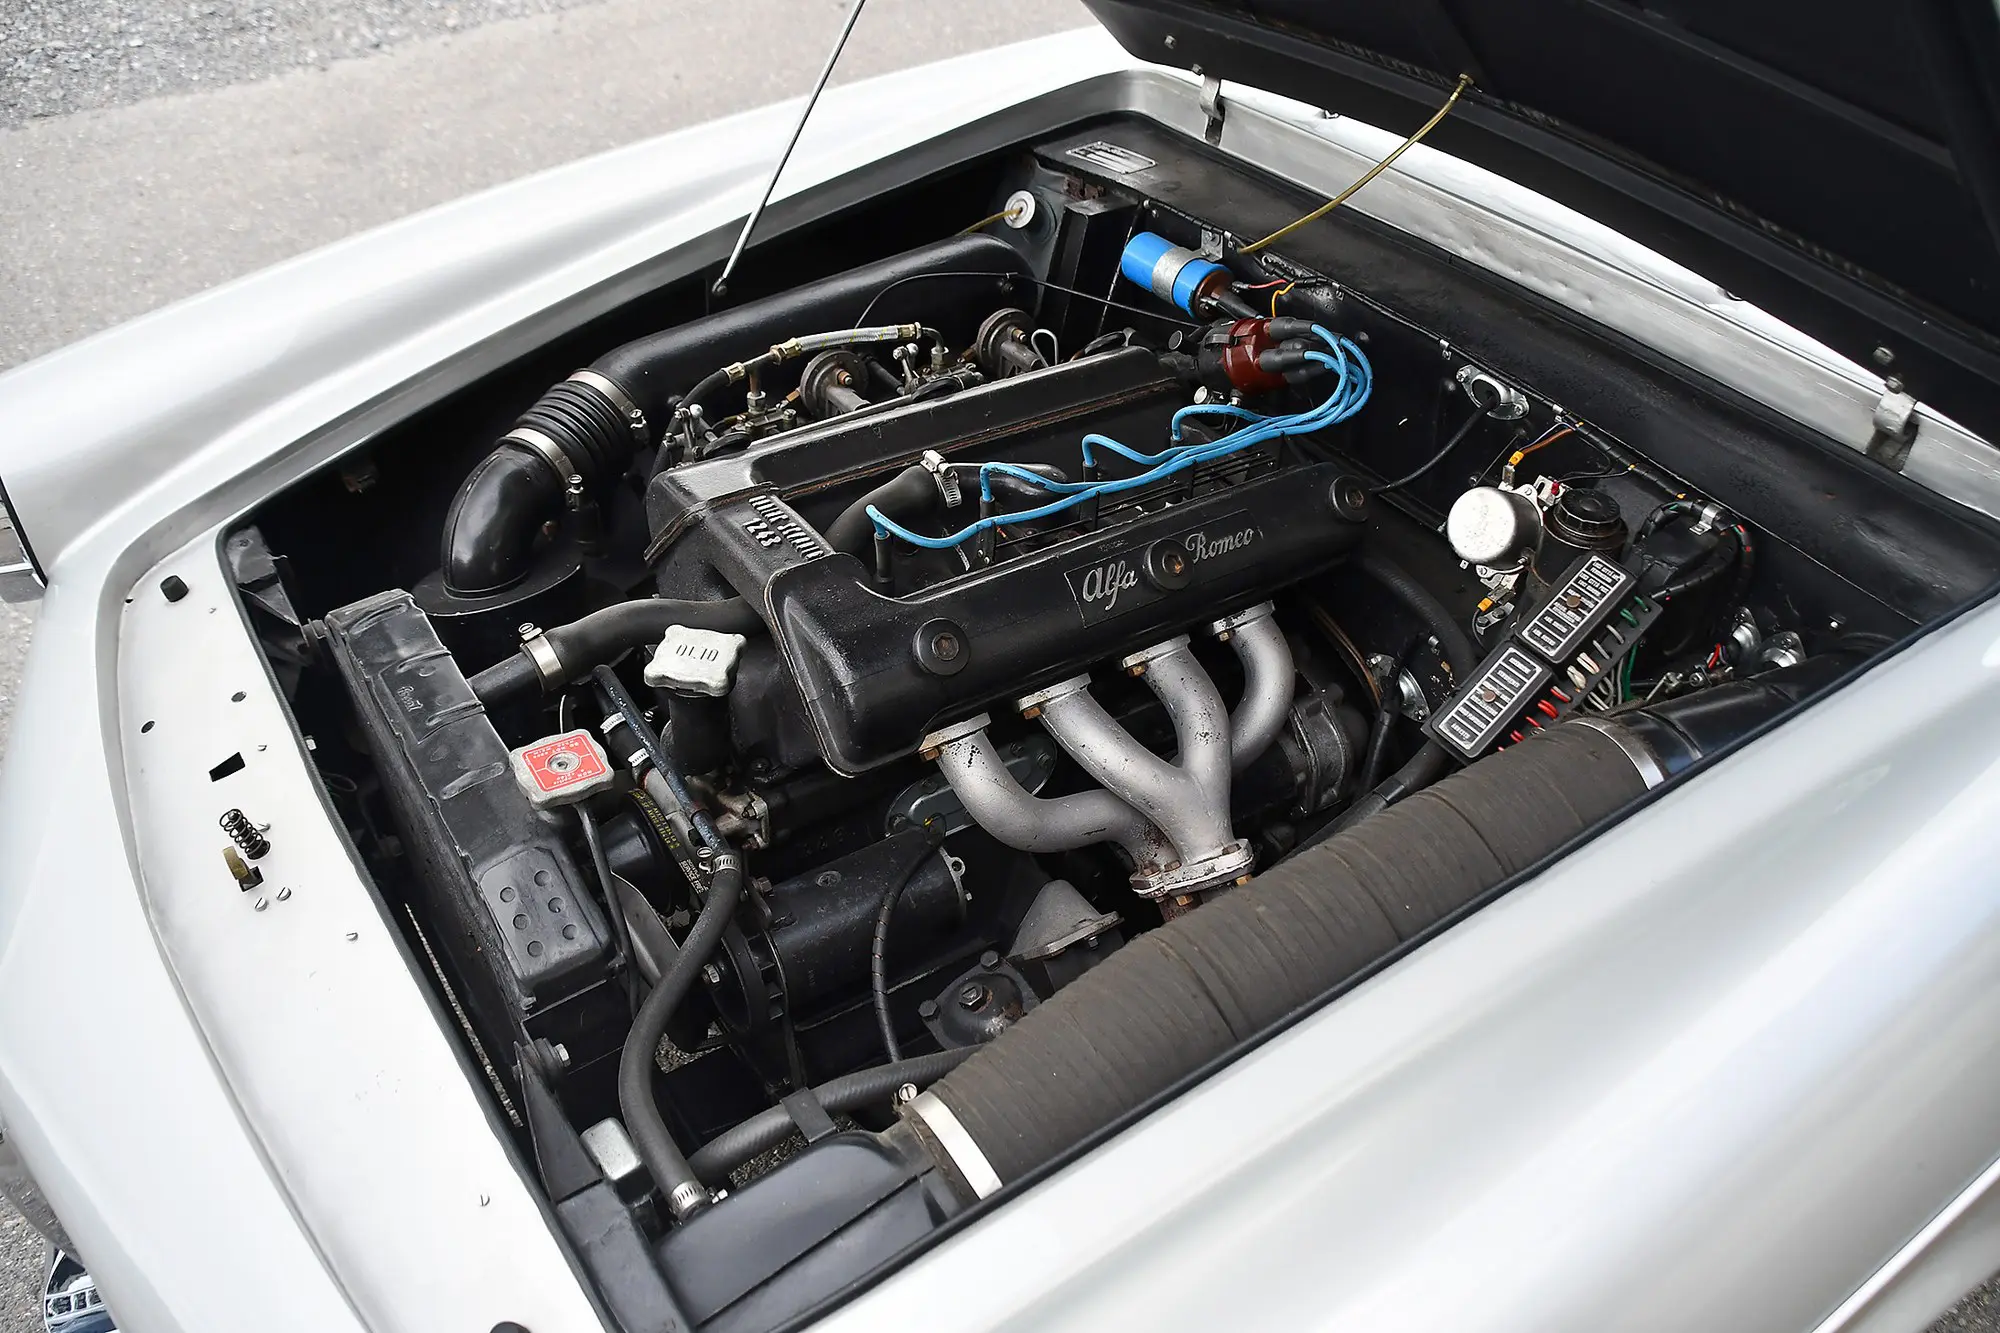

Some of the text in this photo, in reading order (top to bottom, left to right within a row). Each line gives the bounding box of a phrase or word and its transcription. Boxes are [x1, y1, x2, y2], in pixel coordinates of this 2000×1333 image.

[742, 517, 781, 547] 1243
[1082, 527, 1254, 611] Alfa Romeo
